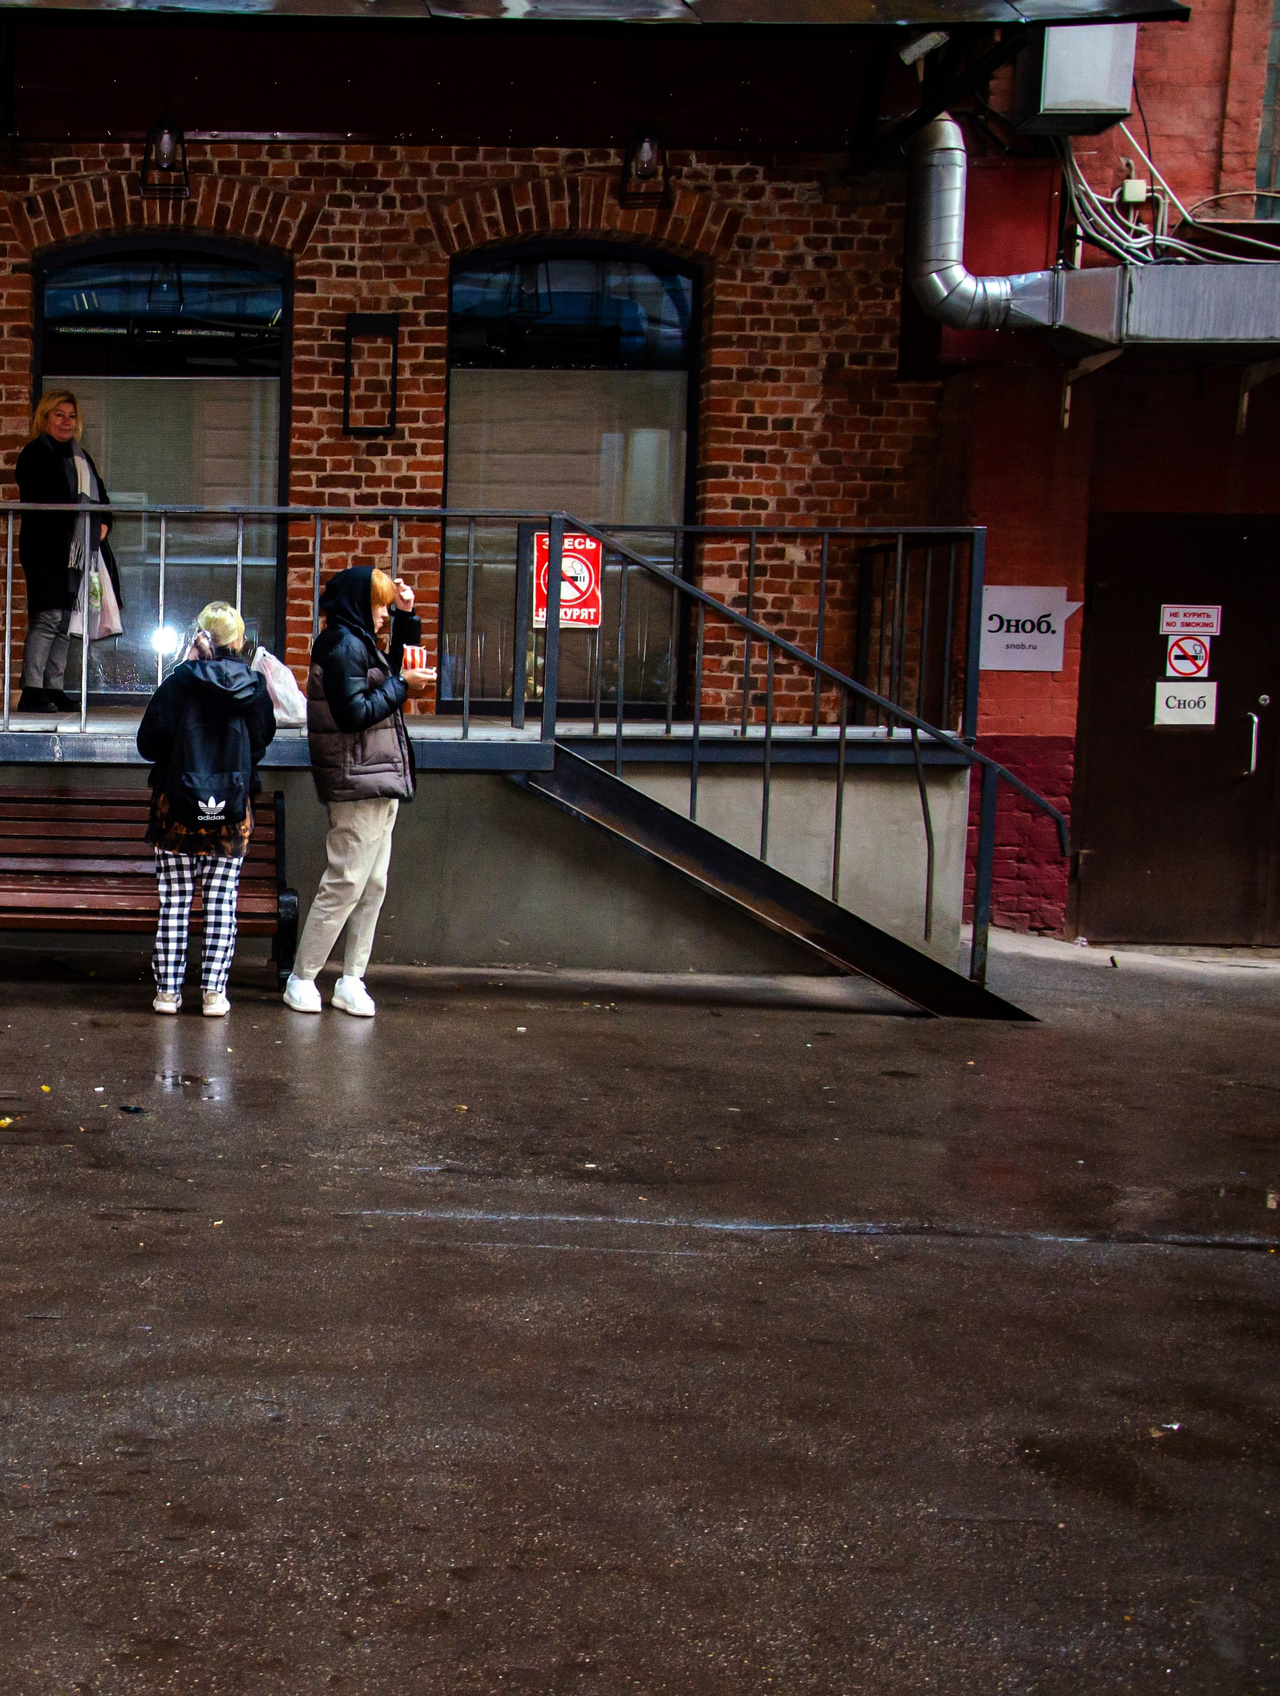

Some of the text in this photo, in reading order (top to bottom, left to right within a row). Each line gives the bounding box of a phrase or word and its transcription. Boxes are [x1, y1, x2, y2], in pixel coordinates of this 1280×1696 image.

[541, 537, 597, 550] ЗЕСЬ
[559, 608, 597, 620] КУРЯТ
[1165, 695, 1207, 709] Сноб
